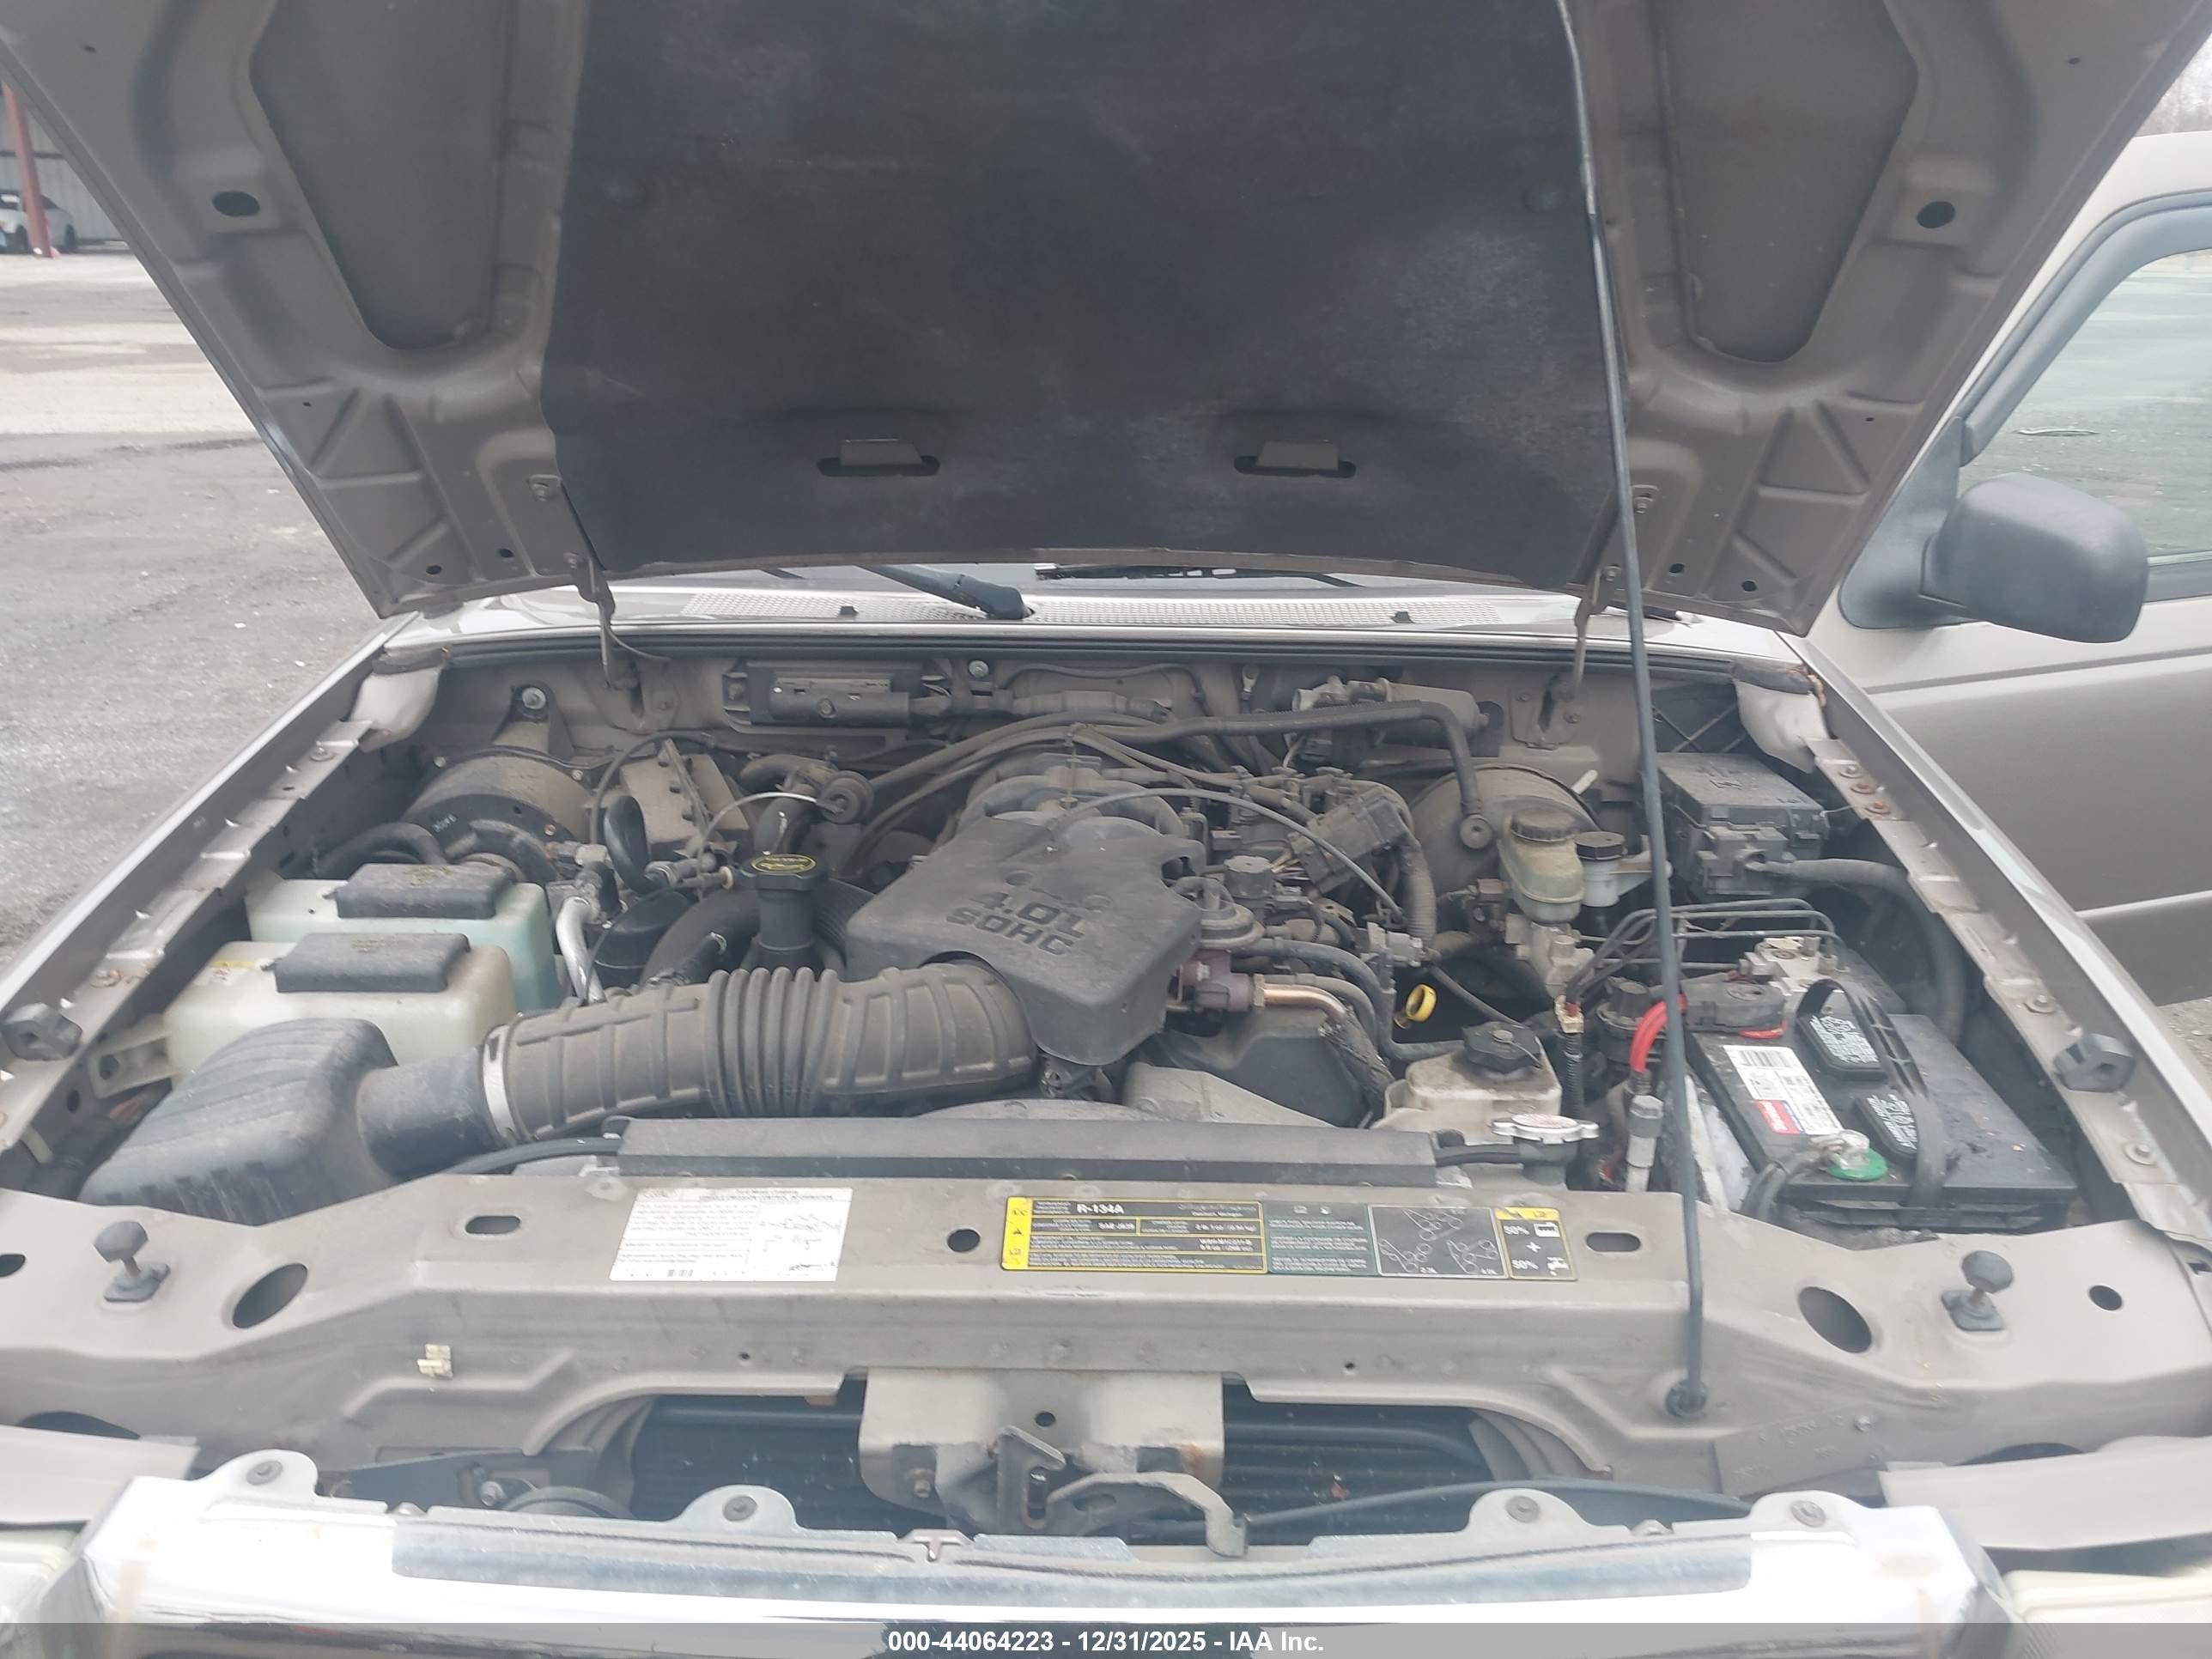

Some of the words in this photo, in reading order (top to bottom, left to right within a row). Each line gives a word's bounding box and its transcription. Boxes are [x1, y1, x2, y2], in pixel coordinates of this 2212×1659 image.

[945, 906, 1075, 956] SOHC
[969, 891, 1085, 939] 4.0L
[1076, 1203, 1125, 1214] R-134A
